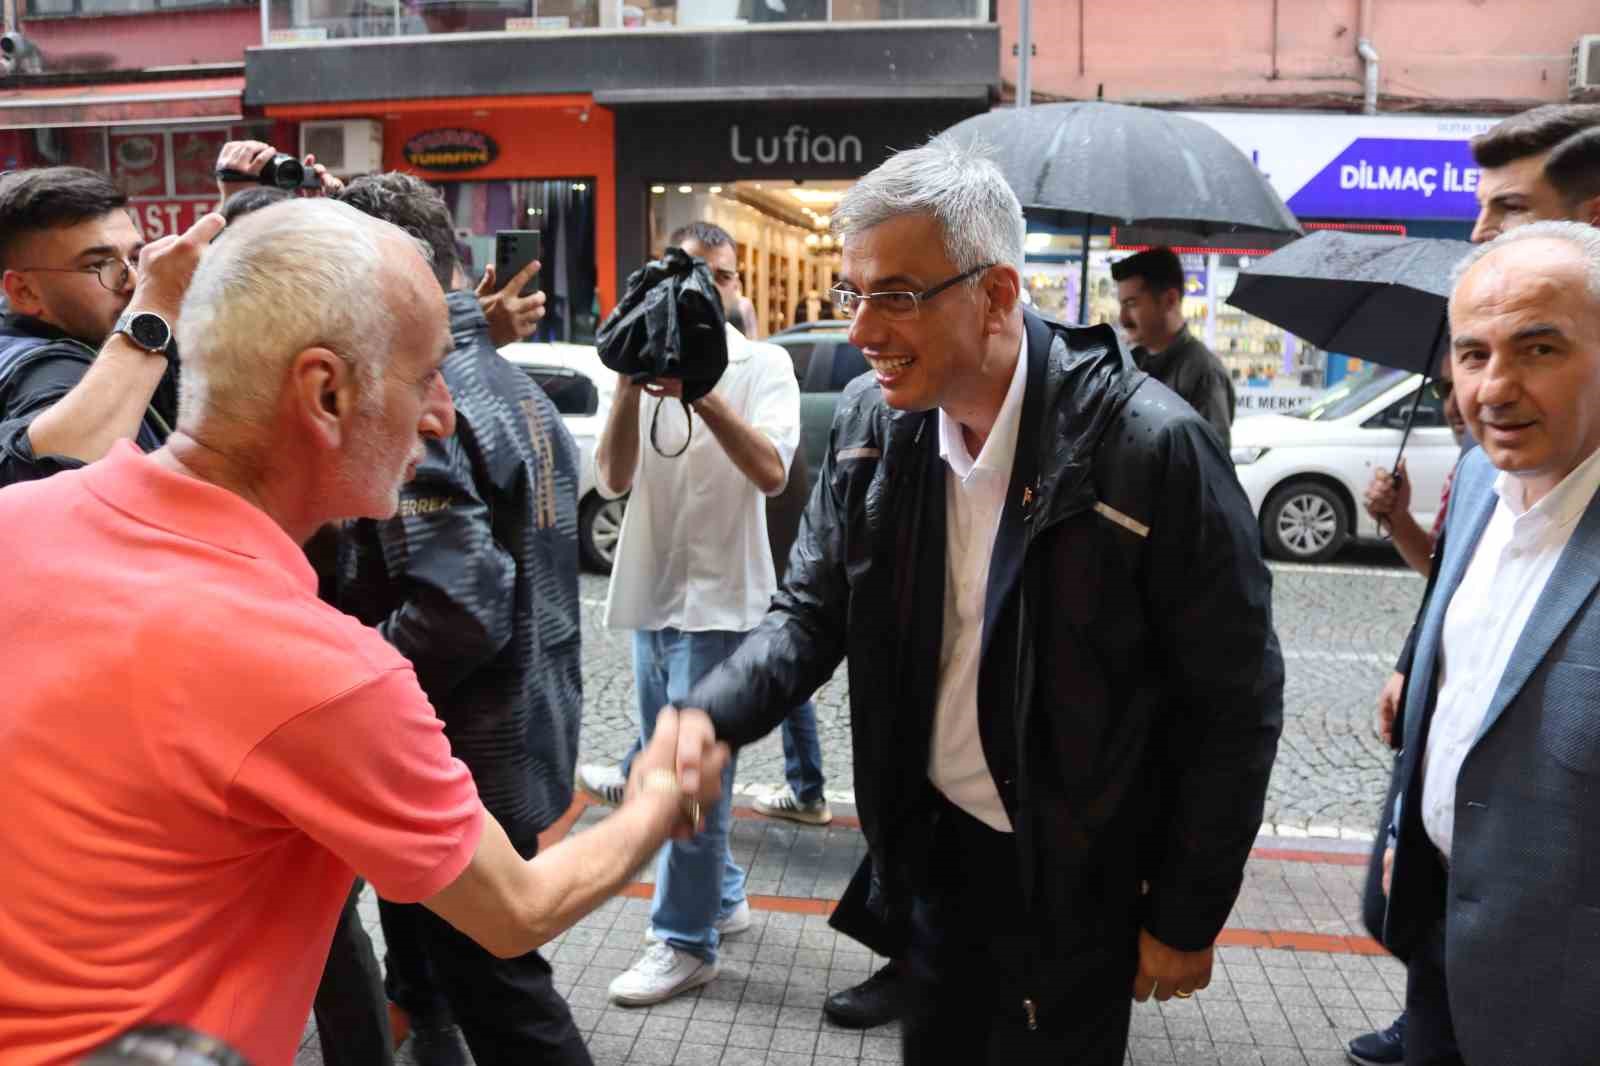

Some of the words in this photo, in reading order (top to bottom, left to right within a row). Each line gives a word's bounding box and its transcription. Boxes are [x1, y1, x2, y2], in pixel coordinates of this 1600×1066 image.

[731, 124, 863, 163] Lufian
[1339, 159, 1438, 198] DİLMAÇ
[1443, 161, 1480, 193] İLE
[128, 203, 182, 240] AST
[1235, 396, 1253, 409] ME
[399, 496, 452, 517] ERREX
